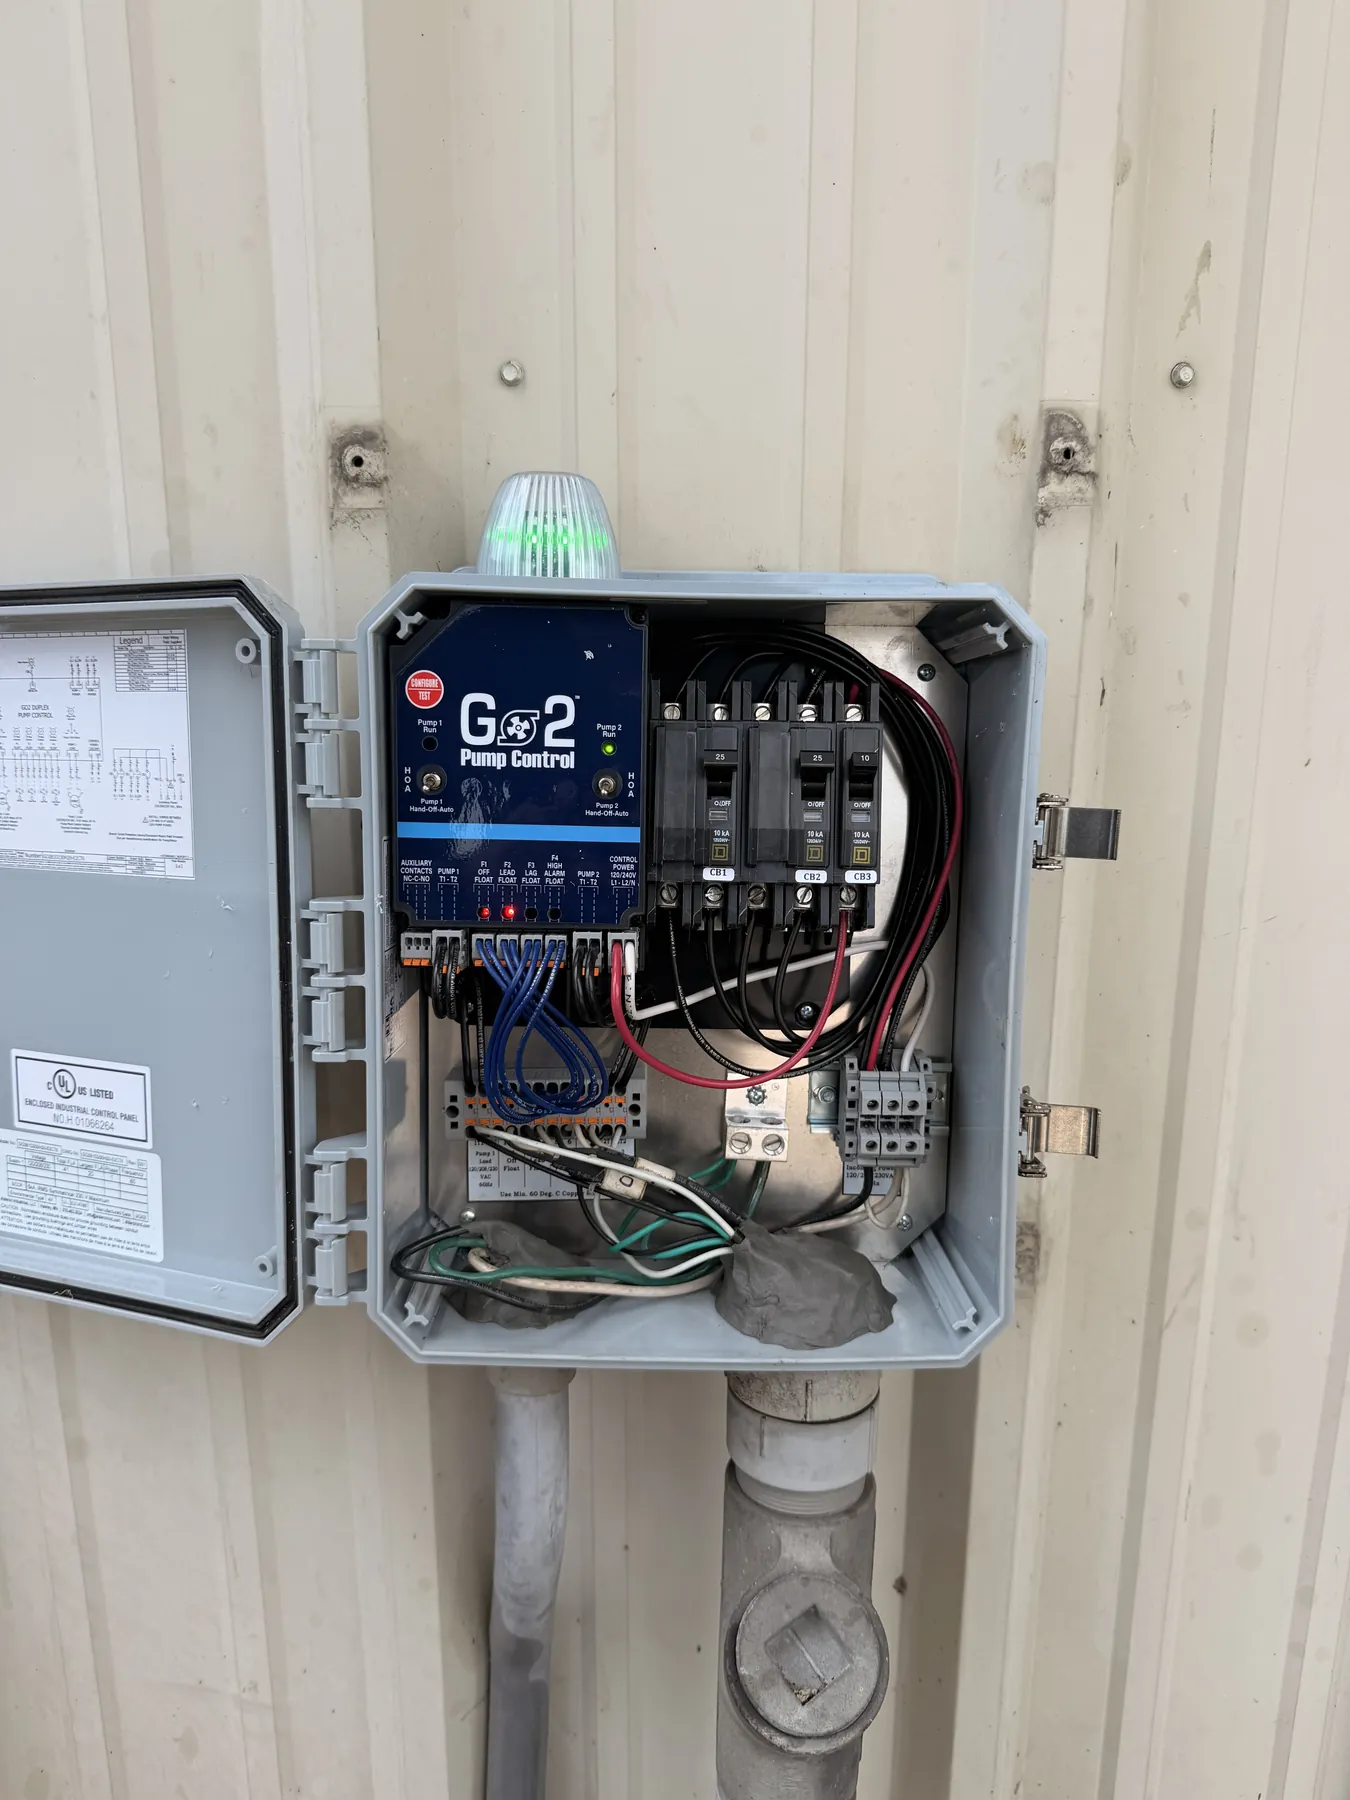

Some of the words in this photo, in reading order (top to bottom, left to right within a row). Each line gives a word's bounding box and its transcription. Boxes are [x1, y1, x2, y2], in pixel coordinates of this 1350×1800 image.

[120, 636, 144, 647] Legend
[411, 678, 439, 688] CONFIGURE
[418, 691, 431, 700] TEST
[418, 719, 438, 728] Pump
[597, 724, 616, 732] Pump
[460, 748, 507, 770] Pump
[511, 749, 576, 769] Control
[420, 798, 439, 806] Pump
[595, 802, 613, 810] Pump
[409, 805, 455, 813] Hand-Off-Auto
[585, 809, 630, 817] Hand-Off-Auto
[721, 829, 730, 837] kA
[401, 859, 433, 867] AUXILIARY
[609, 855, 638, 863] CONTROL
[547, 862, 563, 870] HIGH
[400, 867, 433, 875] CONTACTS
[709, 868, 728, 877] CB1
[474, 876, 494, 884] FLOAT
[803, 873, 821, 881] CB2
[853, 872, 872, 881] CB3
[521, 877, 541, 885] FLOAT
[78, 1086, 88, 1096] US
[89, 1088, 114, 1100] LISTED
[25, 1098, 55, 1110] ENCLOSED
[55, 1103, 90, 1115] INDUSTRIAL
[90, 1108, 119, 1119] CONTROL
[120, 1113, 139, 1123] PANEL
[540, 1190, 554, 1198] Deg.
